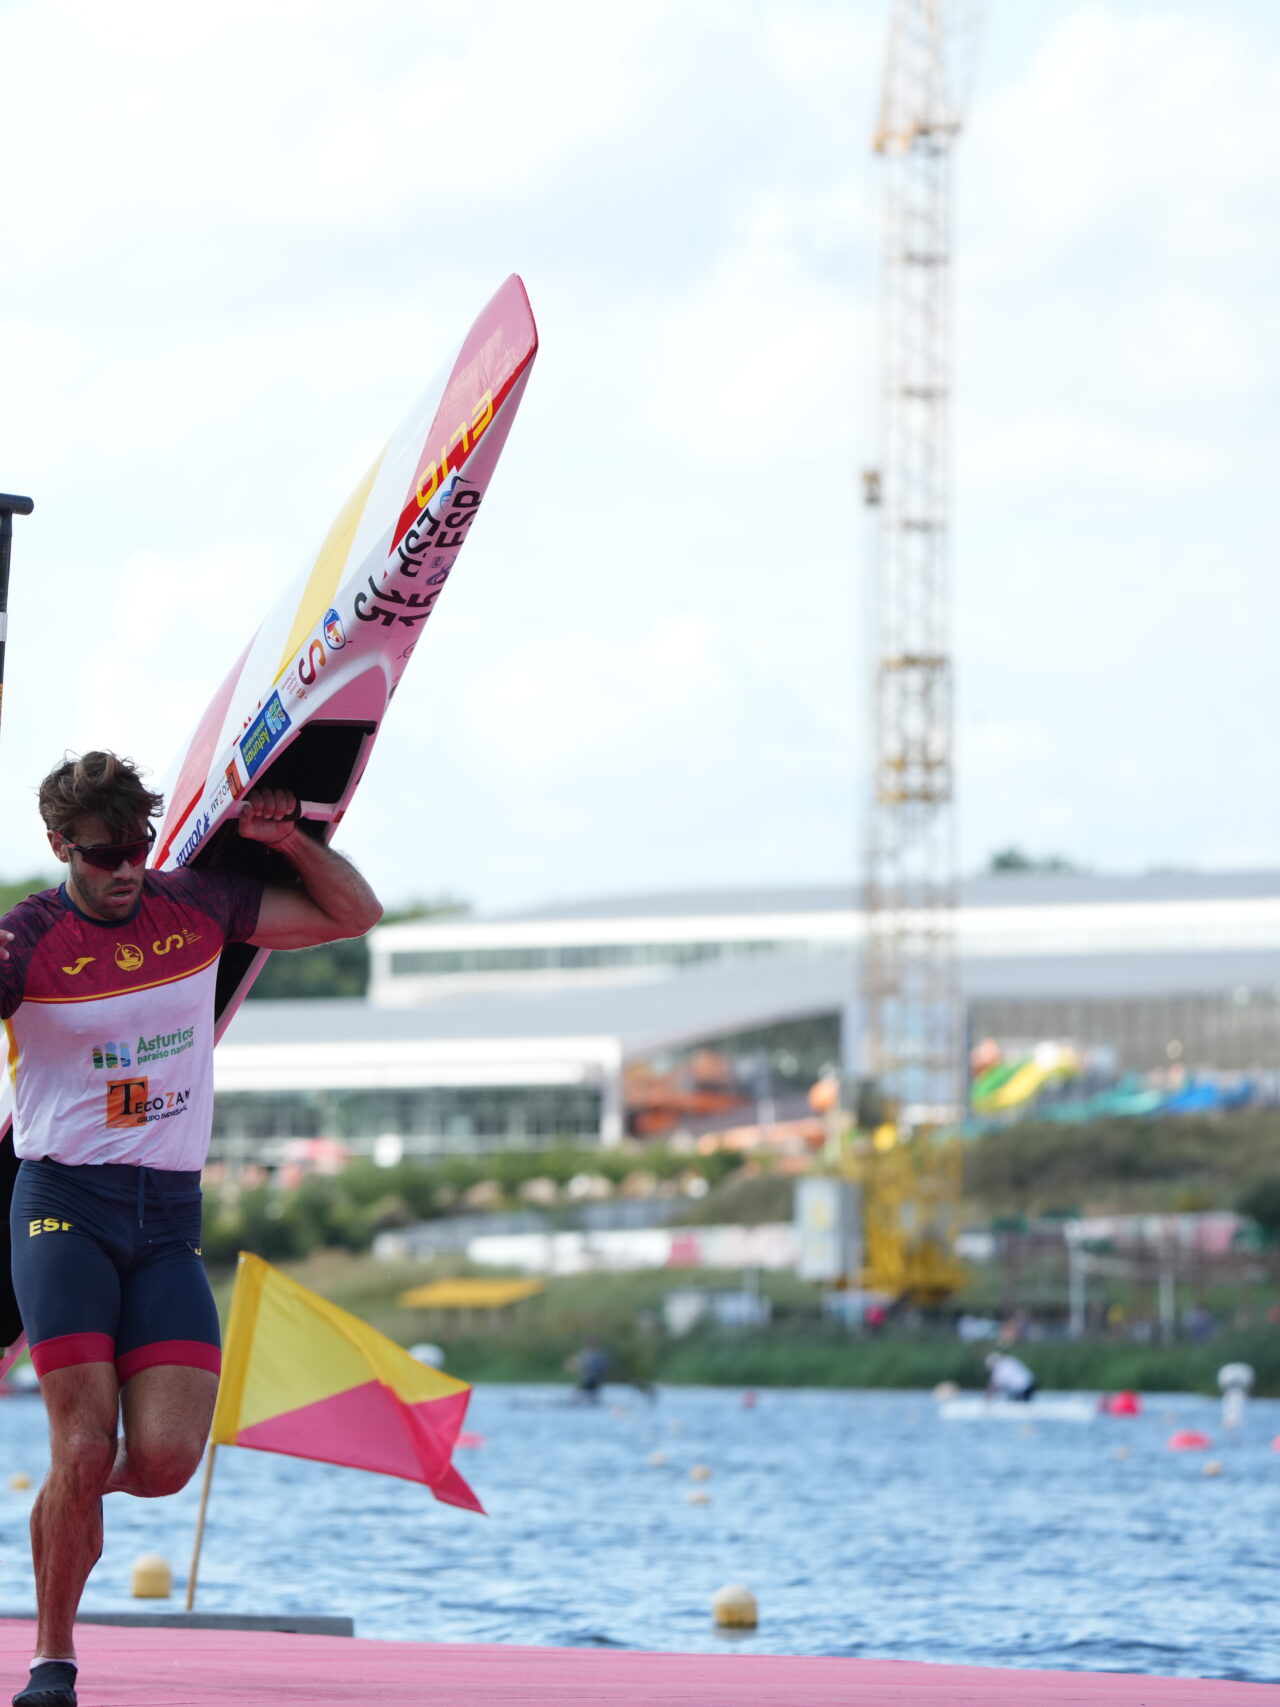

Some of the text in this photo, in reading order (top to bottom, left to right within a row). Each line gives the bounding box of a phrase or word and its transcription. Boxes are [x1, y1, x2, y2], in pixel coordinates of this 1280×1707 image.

[354, 507, 441, 627] ESP 15
[136, 1026, 194, 1054] Asturias
